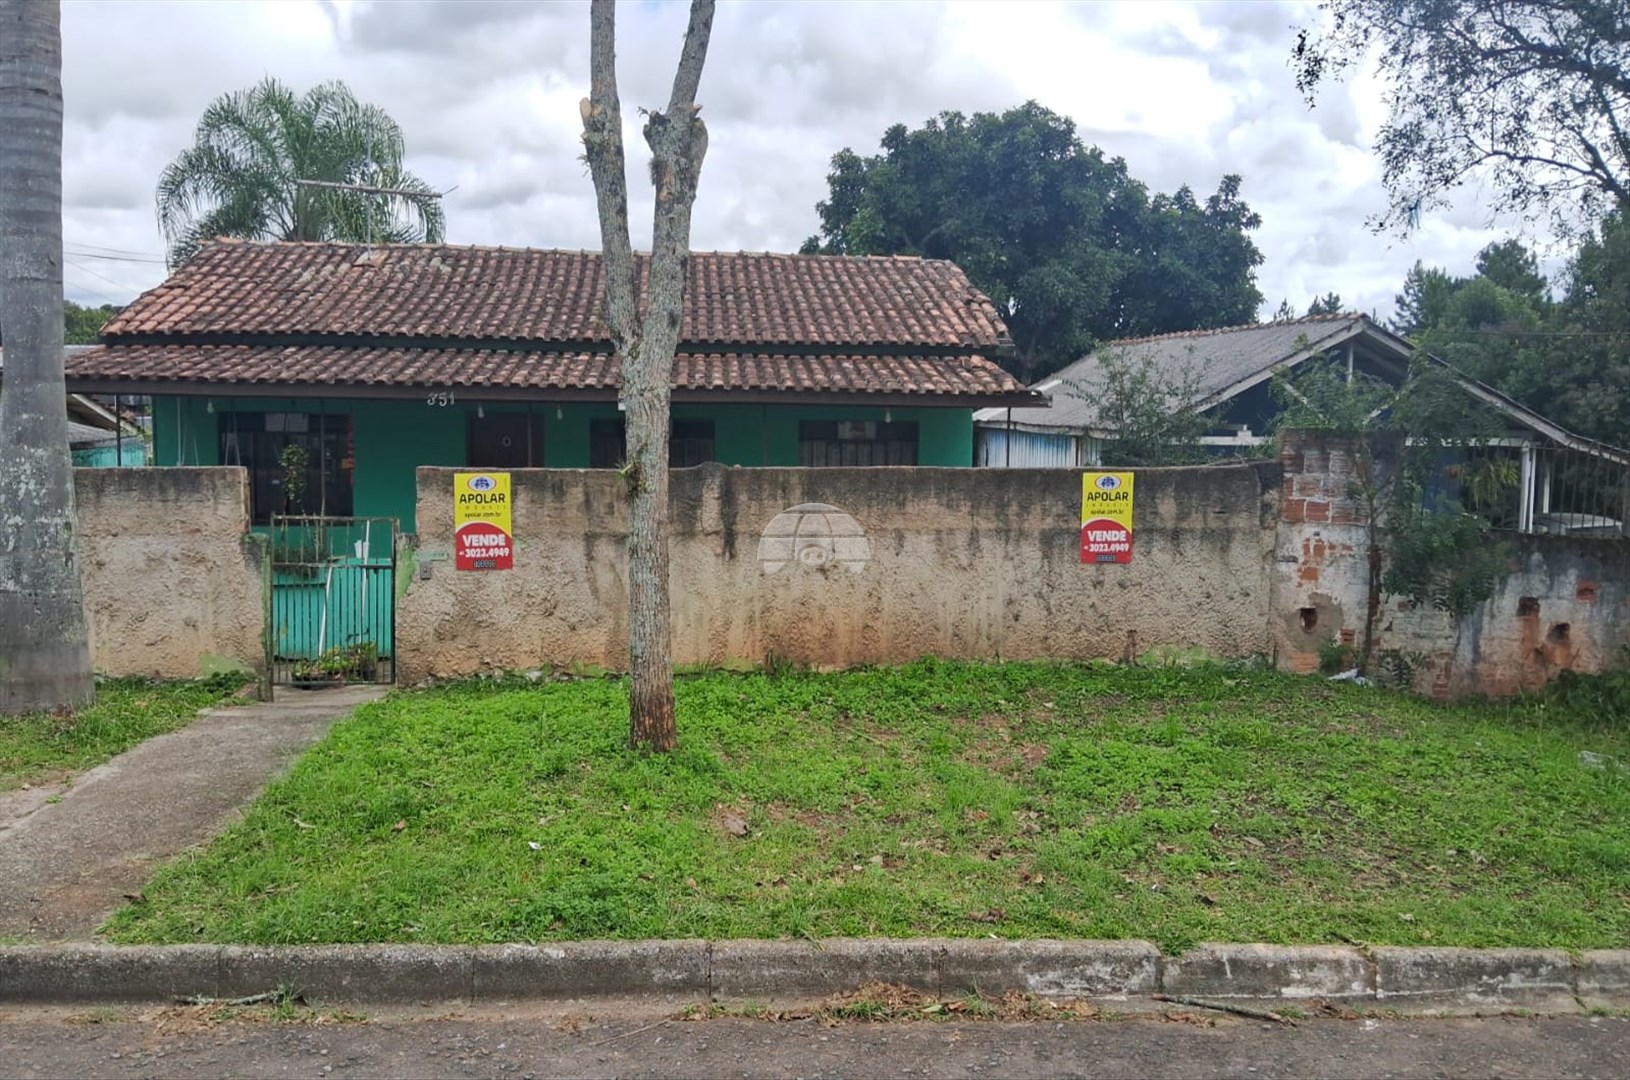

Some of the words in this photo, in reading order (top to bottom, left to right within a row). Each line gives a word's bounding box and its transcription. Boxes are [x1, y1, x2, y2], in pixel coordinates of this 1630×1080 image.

[459, 493, 506, 504] APOLAR
[1087, 492, 1129, 502] APOLAR
[462, 534, 506, 547] VENDE
[1087, 530, 1127, 542] VENDE
[465, 547, 510, 558] 3023.4949
[1089, 543, 1130, 553] 3023.4949
